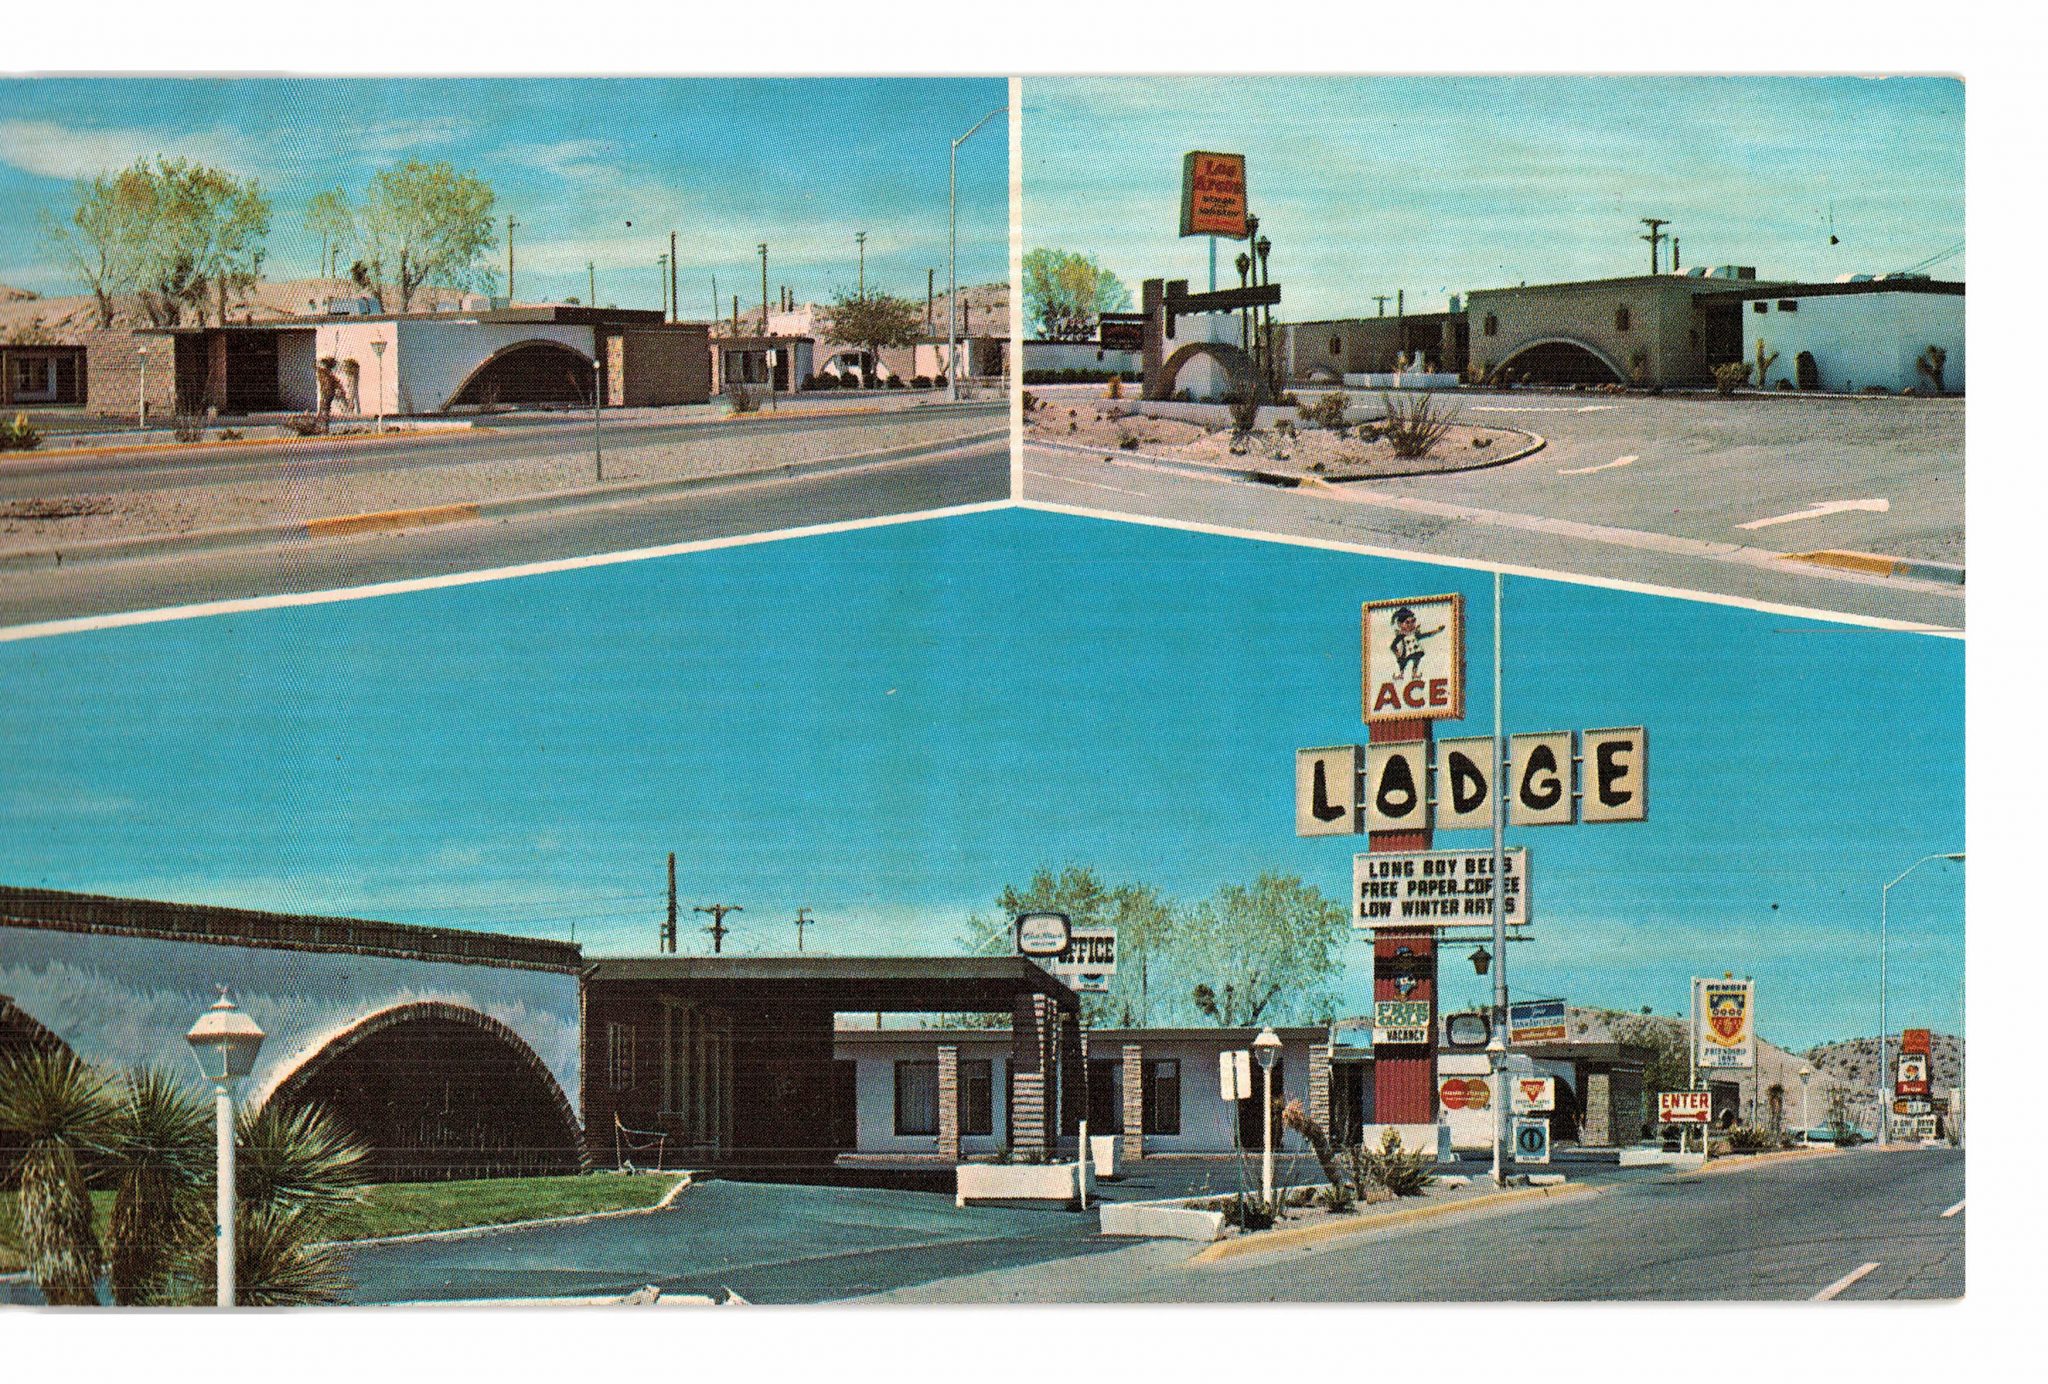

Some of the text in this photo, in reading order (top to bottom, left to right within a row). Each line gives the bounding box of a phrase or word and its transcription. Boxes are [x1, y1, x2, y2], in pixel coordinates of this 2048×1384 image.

[1374, 678, 1449, 711] ACE
[1312, 741, 1633, 822] LODGE
[1369, 861, 1414, 878] LONG
[1424, 859, 1457, 877] BOY
[1361, 881, 1398, 898] FREE
[1465, 876, 1520, 894] COFEE
[1360, 897, 1514, 918] LOW WINTER RATS
[1058, 936, 1114, 963] FFICE
[1378, 1002, 1428, 1017] FREE
[1378, 1014, 1427, 1026] GOLF
[1386, 1029, 1425, 1041] VACANCY
[1662, 1092, 1709, 1109] ENTER
